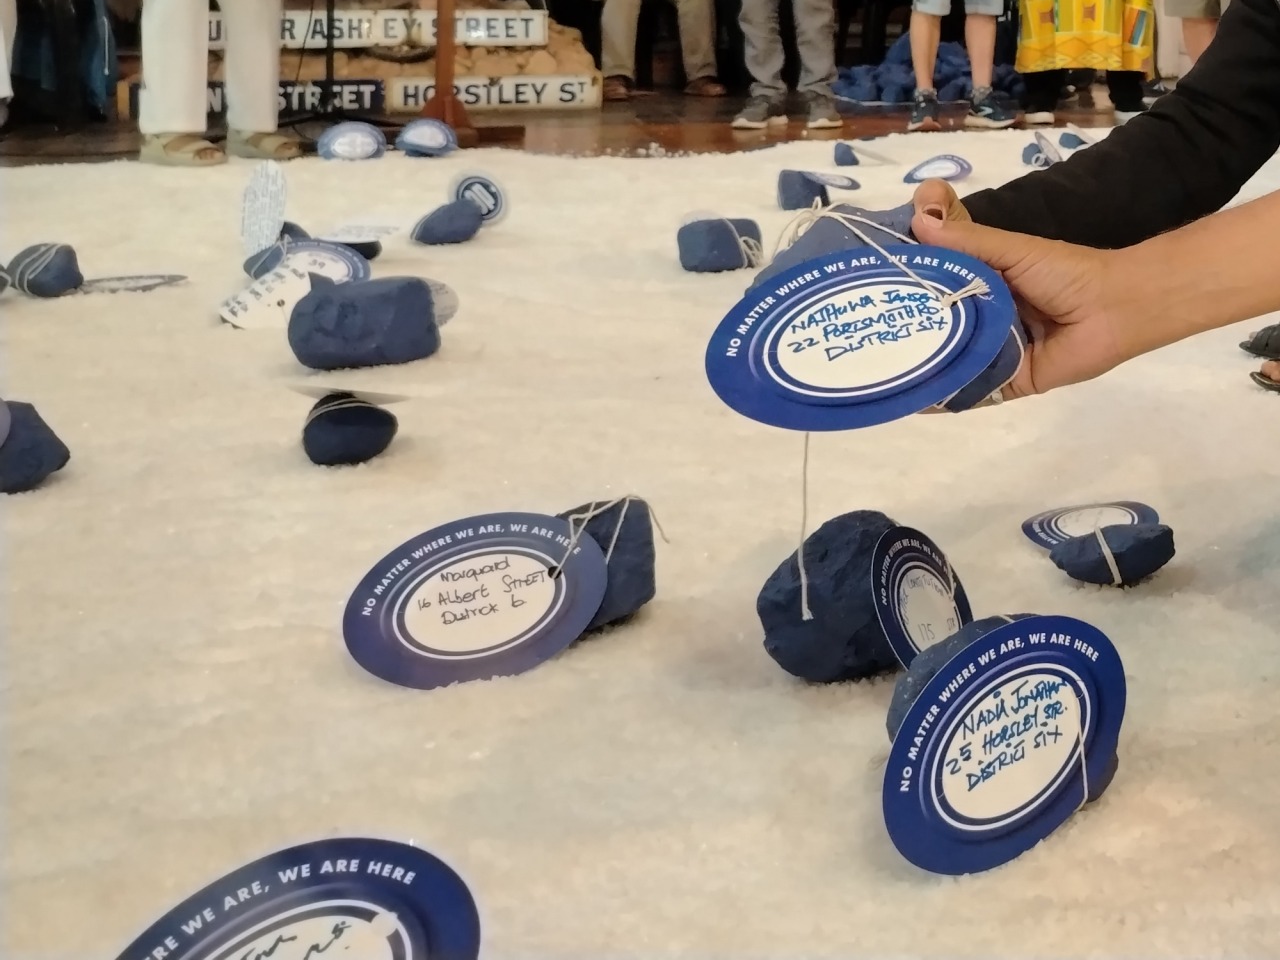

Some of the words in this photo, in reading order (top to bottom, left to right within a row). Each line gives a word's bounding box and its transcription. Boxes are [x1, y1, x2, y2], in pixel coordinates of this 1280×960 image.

[726, 337, 741, 357] NO
[736, 296, 776, 335] MATTER
[775, 270, 821, 297] WHERE
[823, 261, 846, 273] WE
[851, 256, 881, 268] ARE,
[888, 255, 908, 264] WE
[913, 255, 940, 267] ARE
[943, 261, 976, 280] HERE
[787, 337, 819, 353] 22
[362, 597, 376, 616] NO
[374, 558, 412, 595] MATTER
[411, 535, 453, 559] WHERE
[455, 527, 474, 540] WE
[478, 524, 505, 535] ARE,
[510, 523, 528, 532] WE
[531, 526, 554, 538] ARE
[900, 766, 912, 792] NO
[908, 706, 940, 760] MATTER
[938, 662, 976, 703] WHERE
[977, 648, 996, 666] WE
[1000, 637, 1025, 656] ARE,
[1029, 633, 1046, 644] WE
[1050, 633, 1070, 646] ARE
[1073, 639, 1099, 662] HERE
[946, 742, 972, 776] 25
[182, 908, 216, 935] WE
[224, 881, 270, 911] ARE,
[278, 863, 311, 883] WE
[320, 858, 360, 874] ARE
[367, 860, 416, 885] HERE
